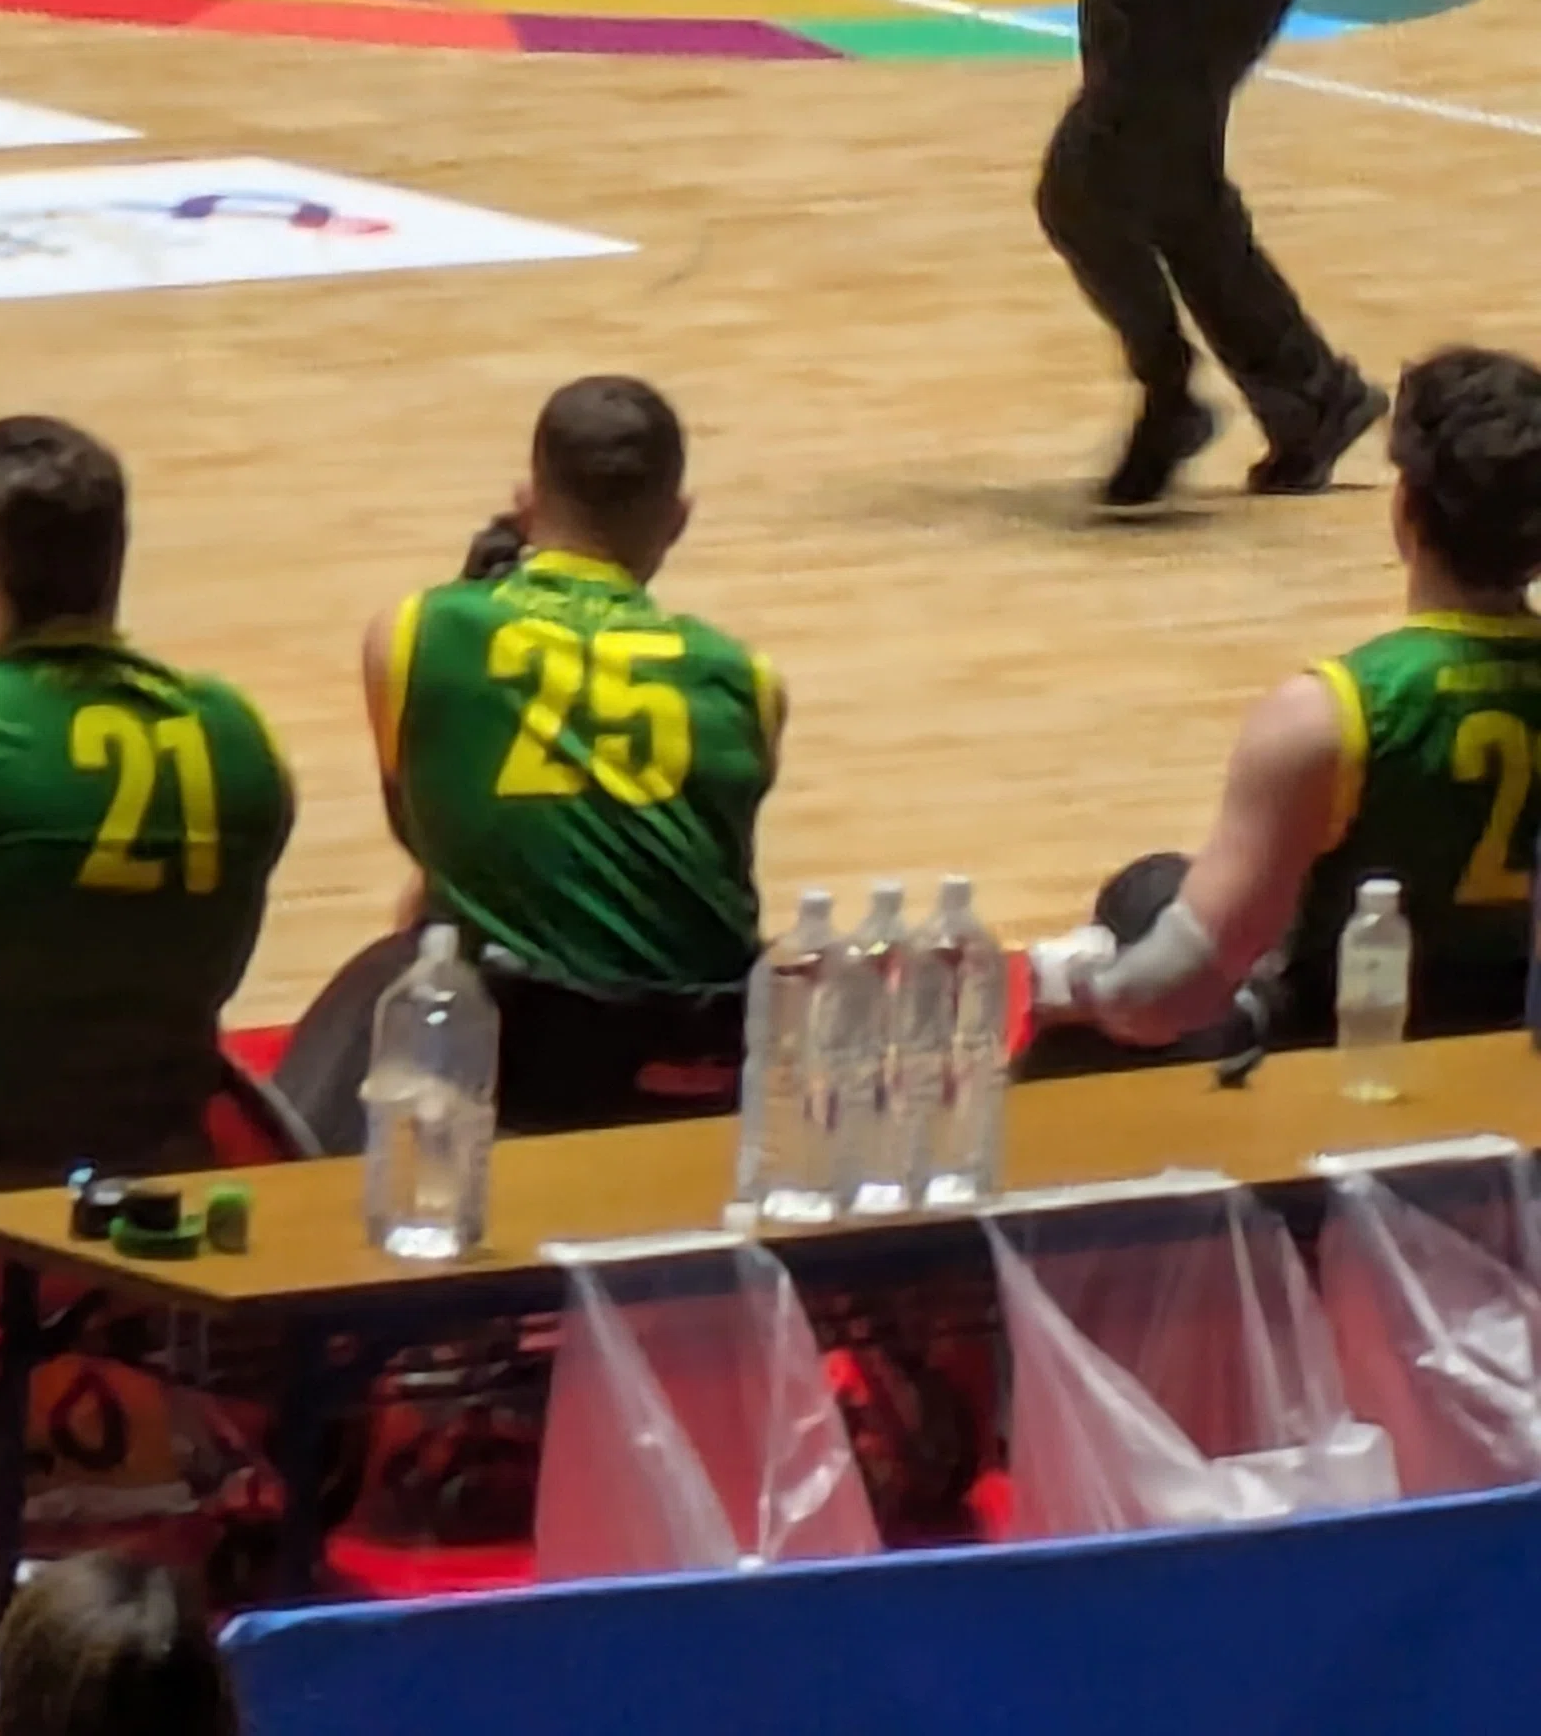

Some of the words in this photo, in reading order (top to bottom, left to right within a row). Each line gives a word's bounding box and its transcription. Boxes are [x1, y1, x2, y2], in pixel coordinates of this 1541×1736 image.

[72, 704, 218, 894] 21
[487, 617, 693, 805] 25
[1452, 710, 1541, 905] 2
